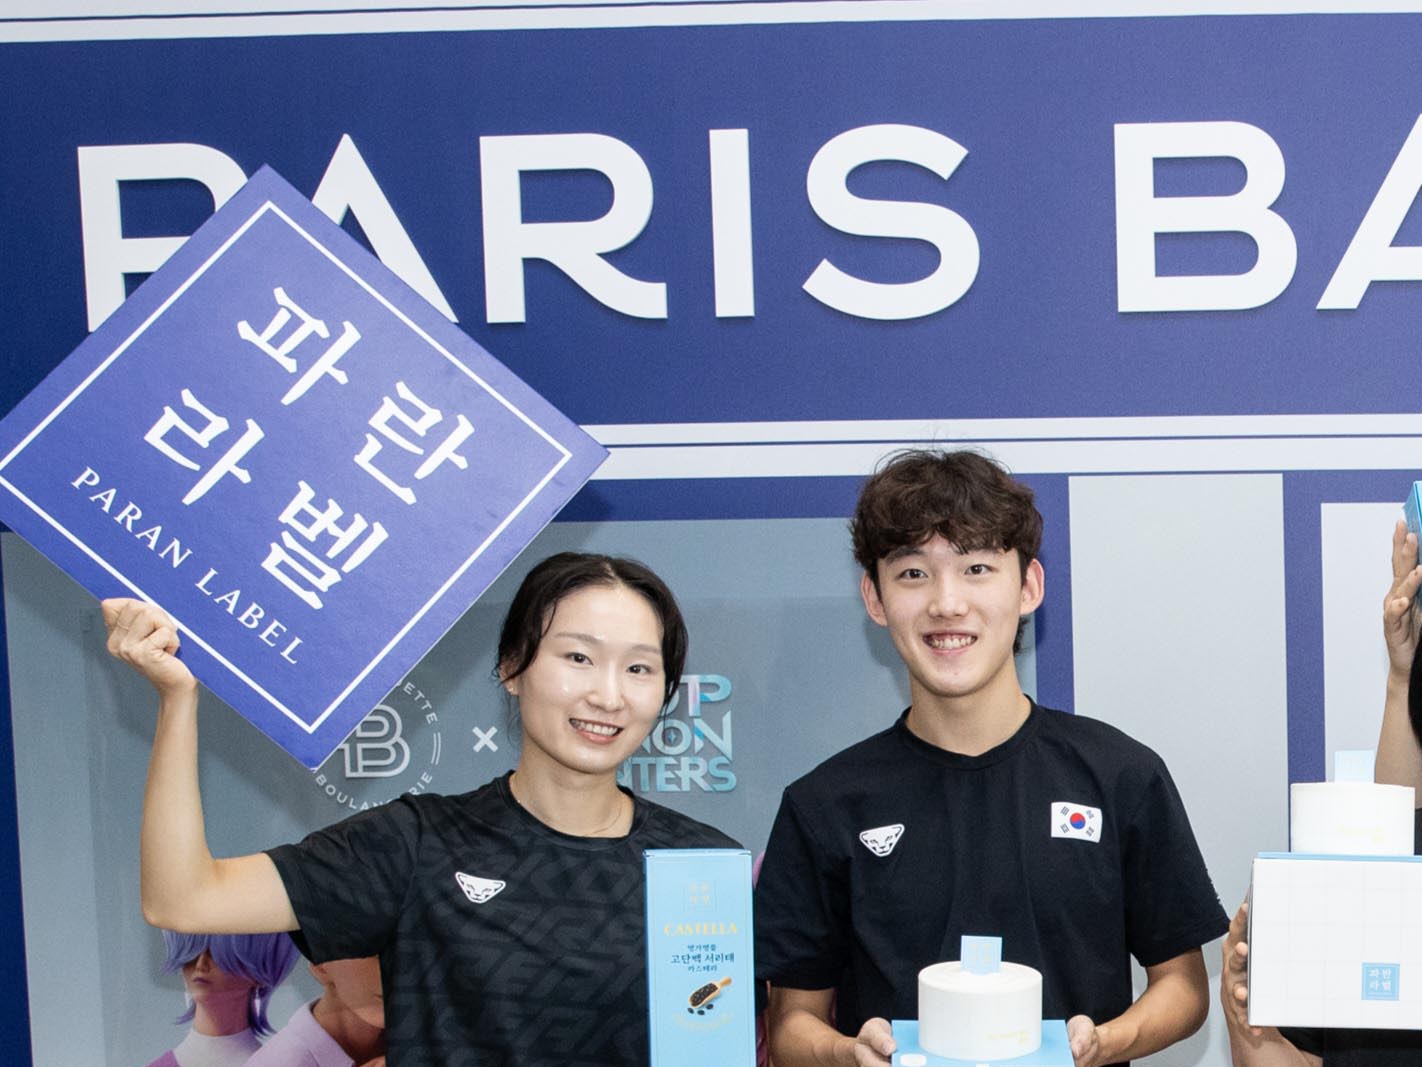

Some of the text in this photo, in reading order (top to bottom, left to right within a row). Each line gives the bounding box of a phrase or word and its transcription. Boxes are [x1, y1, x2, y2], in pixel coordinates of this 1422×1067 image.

[78, 122, 979, 332] PARIS
[70, 465, 304, 665] PARAN LABEL
[662, 920, 738, 937] CASTELLA
